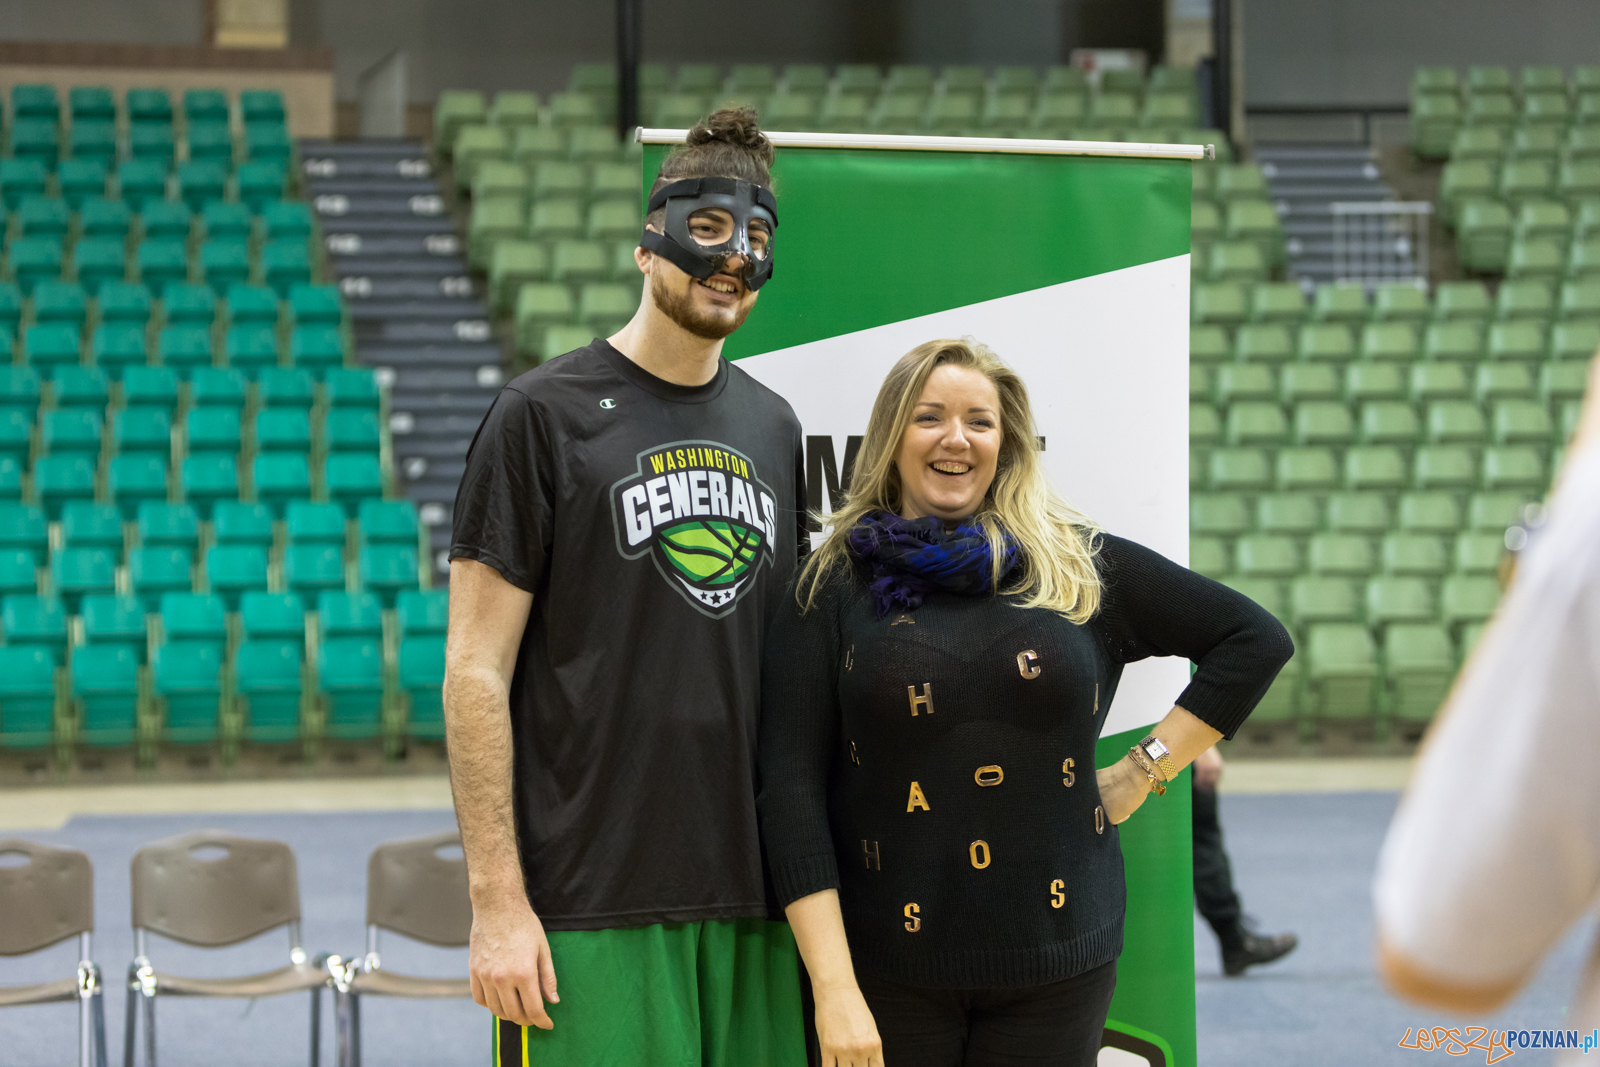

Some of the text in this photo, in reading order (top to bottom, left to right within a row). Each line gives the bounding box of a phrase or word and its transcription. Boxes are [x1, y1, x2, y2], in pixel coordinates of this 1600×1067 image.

[650, 447, 749, 479] WASHINGTON
[622, 470, 775, 553] GENERALS
[1016, 649, 1041, 680] C
[907, 682, 934, 716] H
[1062, 757, 1075, 788] S
[906, 780, 931, 812] A
[969, 839, 991, 869] O
[1050, 878, 1065, 909] S
[903, 902, 921, 933] S
